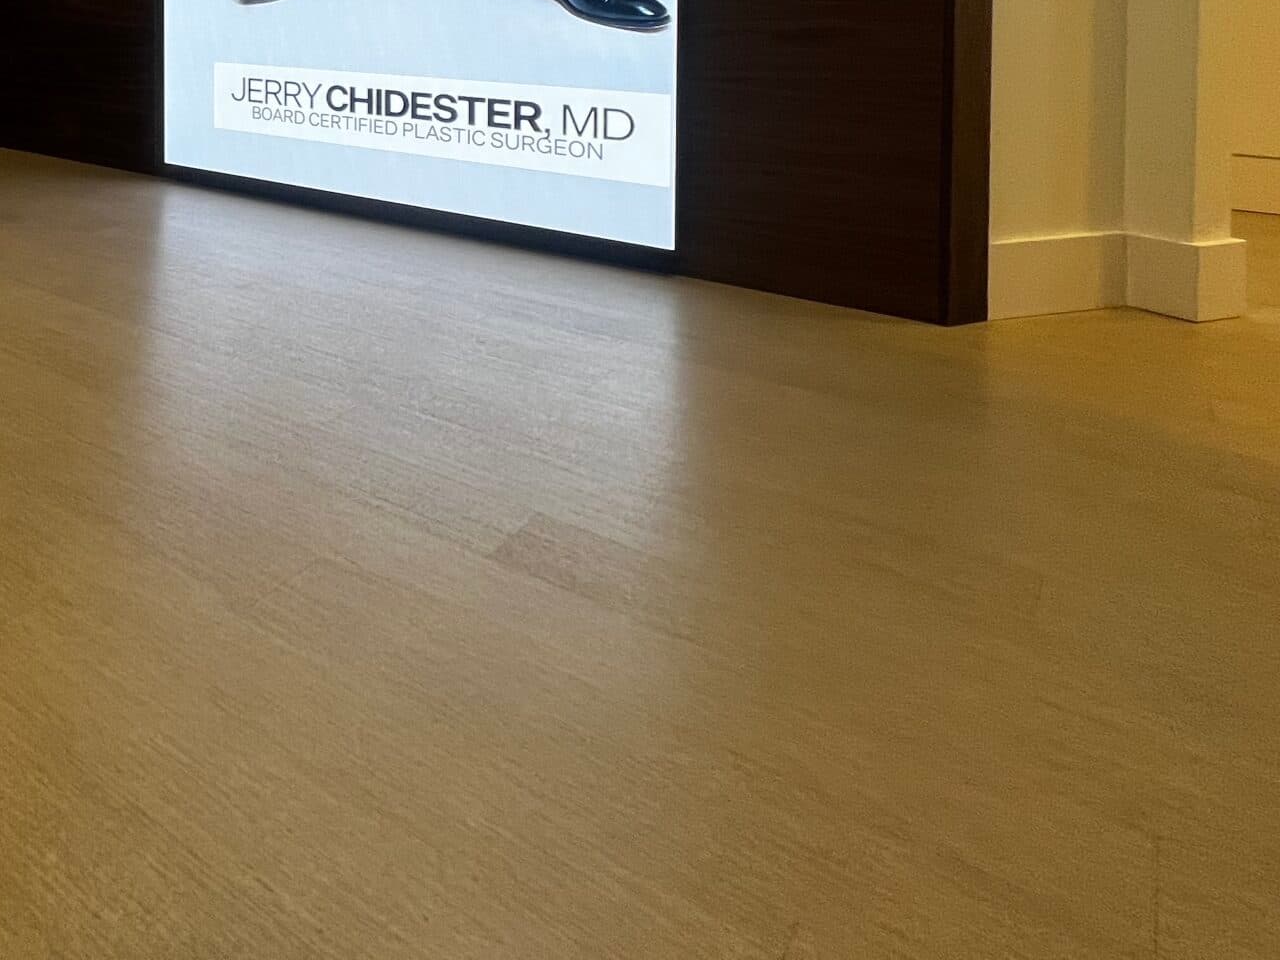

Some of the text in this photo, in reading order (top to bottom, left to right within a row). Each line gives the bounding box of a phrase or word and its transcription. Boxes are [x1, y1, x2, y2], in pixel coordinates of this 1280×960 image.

[231, 77, 635, 141] JERRY CHIDESTER, MD
[252, 106, 604, 160] BOARD CERTIFIED PLASTIC SURGEON
